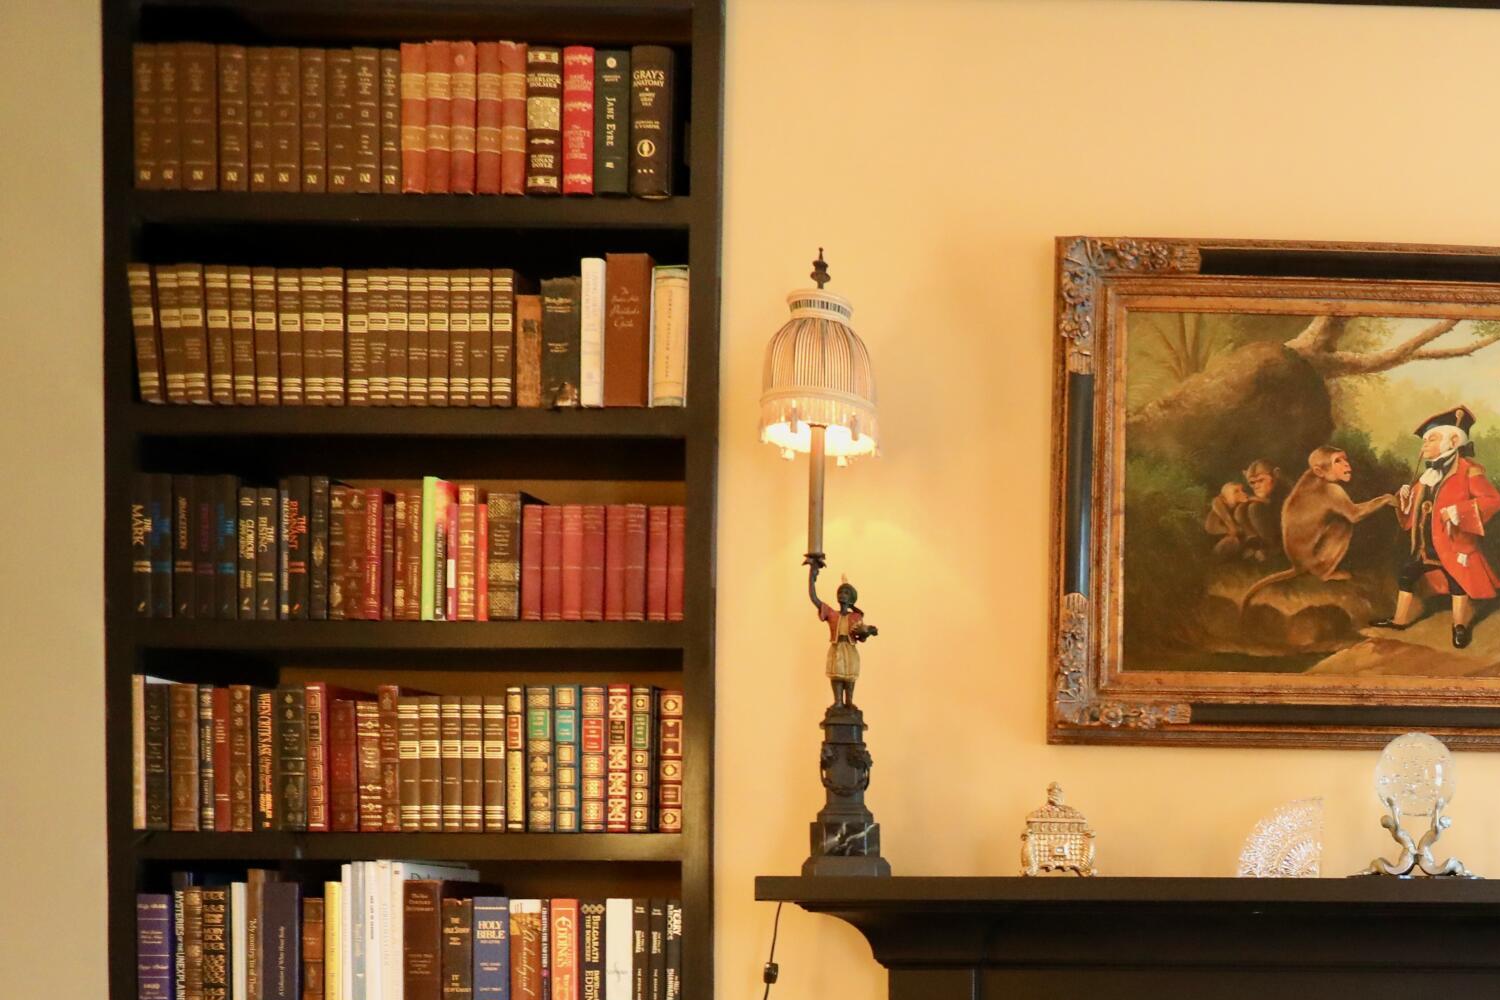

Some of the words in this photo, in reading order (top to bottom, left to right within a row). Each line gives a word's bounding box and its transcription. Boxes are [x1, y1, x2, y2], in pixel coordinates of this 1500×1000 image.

[633, 70, 665, 80] GRAY'S
[606, 97, 616, 120] JANE
[606, 123, 616, 147] EYRE
[132, 504, 145, 547] MARK
[258, 516, 268, 553] RISING
[267, 525, 275, 544] THE
[289, 500, 299, 550] REMNANT
[258, 693, 272, 715] WHEN
[258, 715, 272, 743] CRITICS
[258, 743, 272, 757] ASK
[175, 891, 185, 936] MYSTERIES
[478, 921, 503, 930] HOLY
[672, 908, 682, 936] TERRY
[476, 930, 506, 939] BIBLE
[592, 915, 601, 962] BELGARATH
